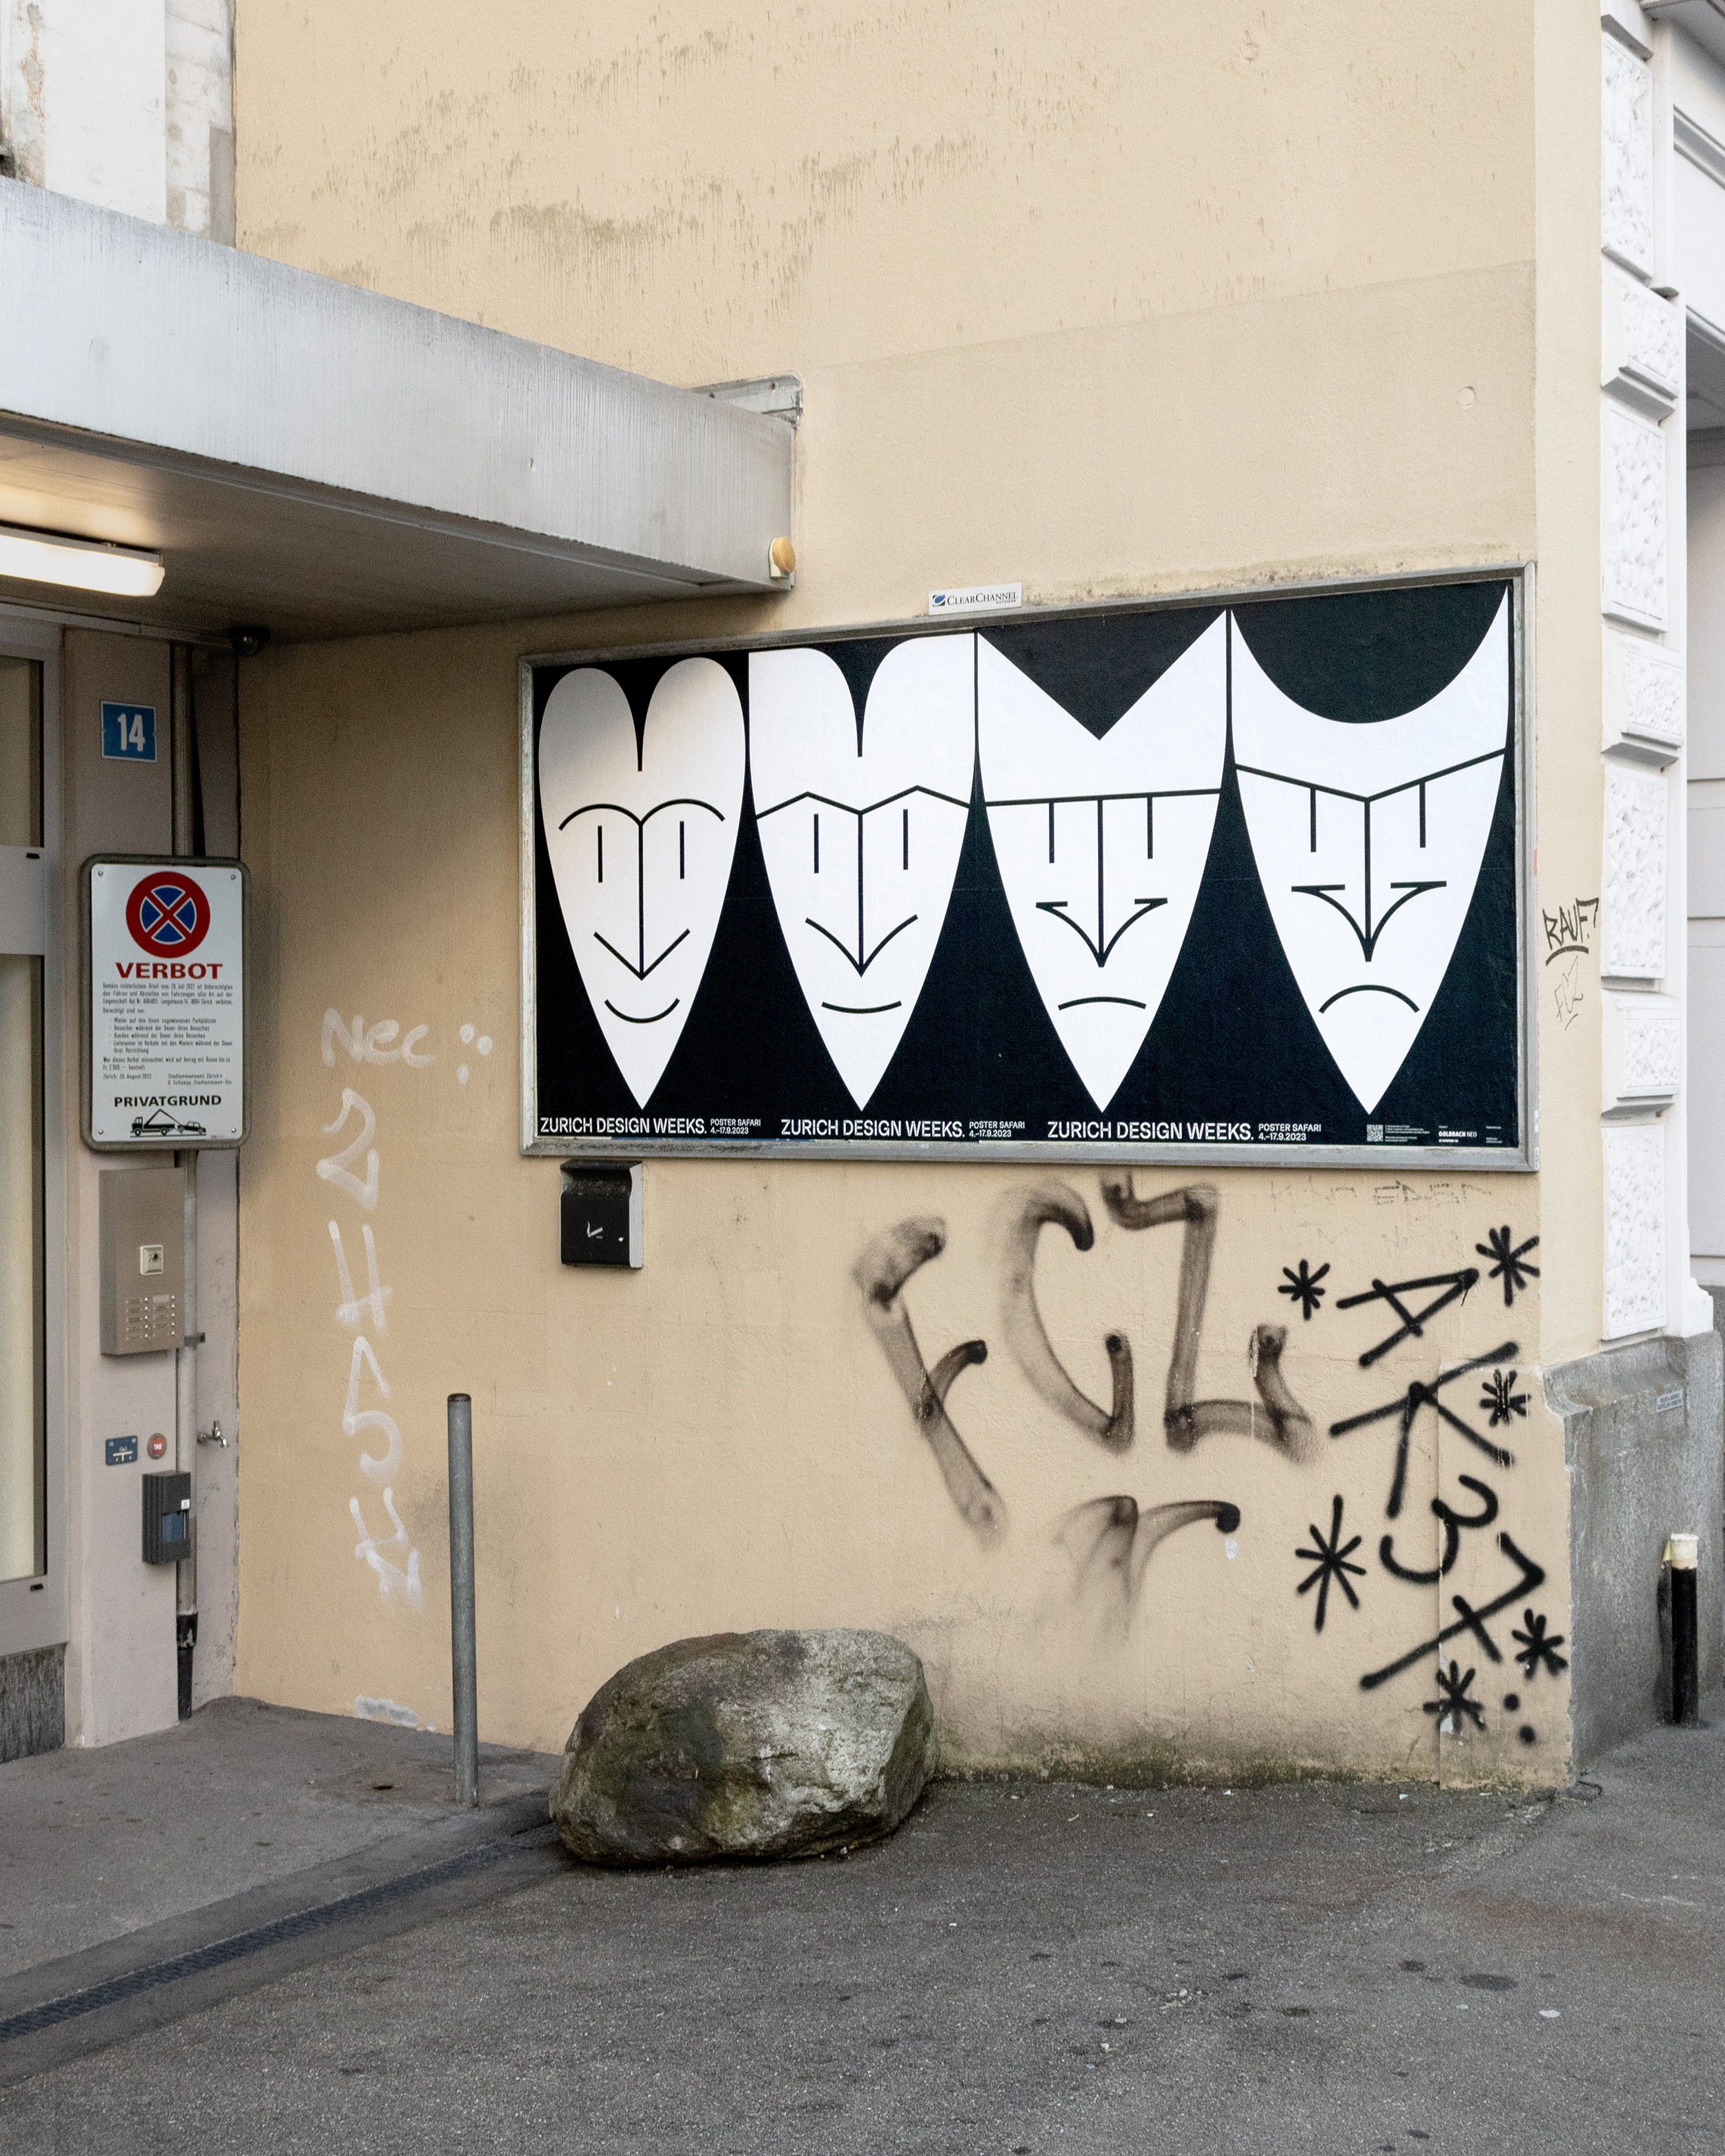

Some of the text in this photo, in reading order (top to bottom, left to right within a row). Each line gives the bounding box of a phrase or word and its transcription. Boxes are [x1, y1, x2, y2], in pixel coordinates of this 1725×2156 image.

[117, 713, 146, 752] 14
[115, 962, 223, 979] VERBOT
[114, 1095, 221, 1107] PRIVATGRUND
[540, 1117, 707, 1134] ZURICH DESIGN WEEKS.
[781, 1119, 965, 1137] ZURICH DESIGN WEEKS.
[999, 1121, 1025, 1129] SAFARI
[1047, 1120, 1254, 1140] ZURICH DESIGN WEEKS.
[1259, 1123, 1321, 1132] POSTER SAFARI
